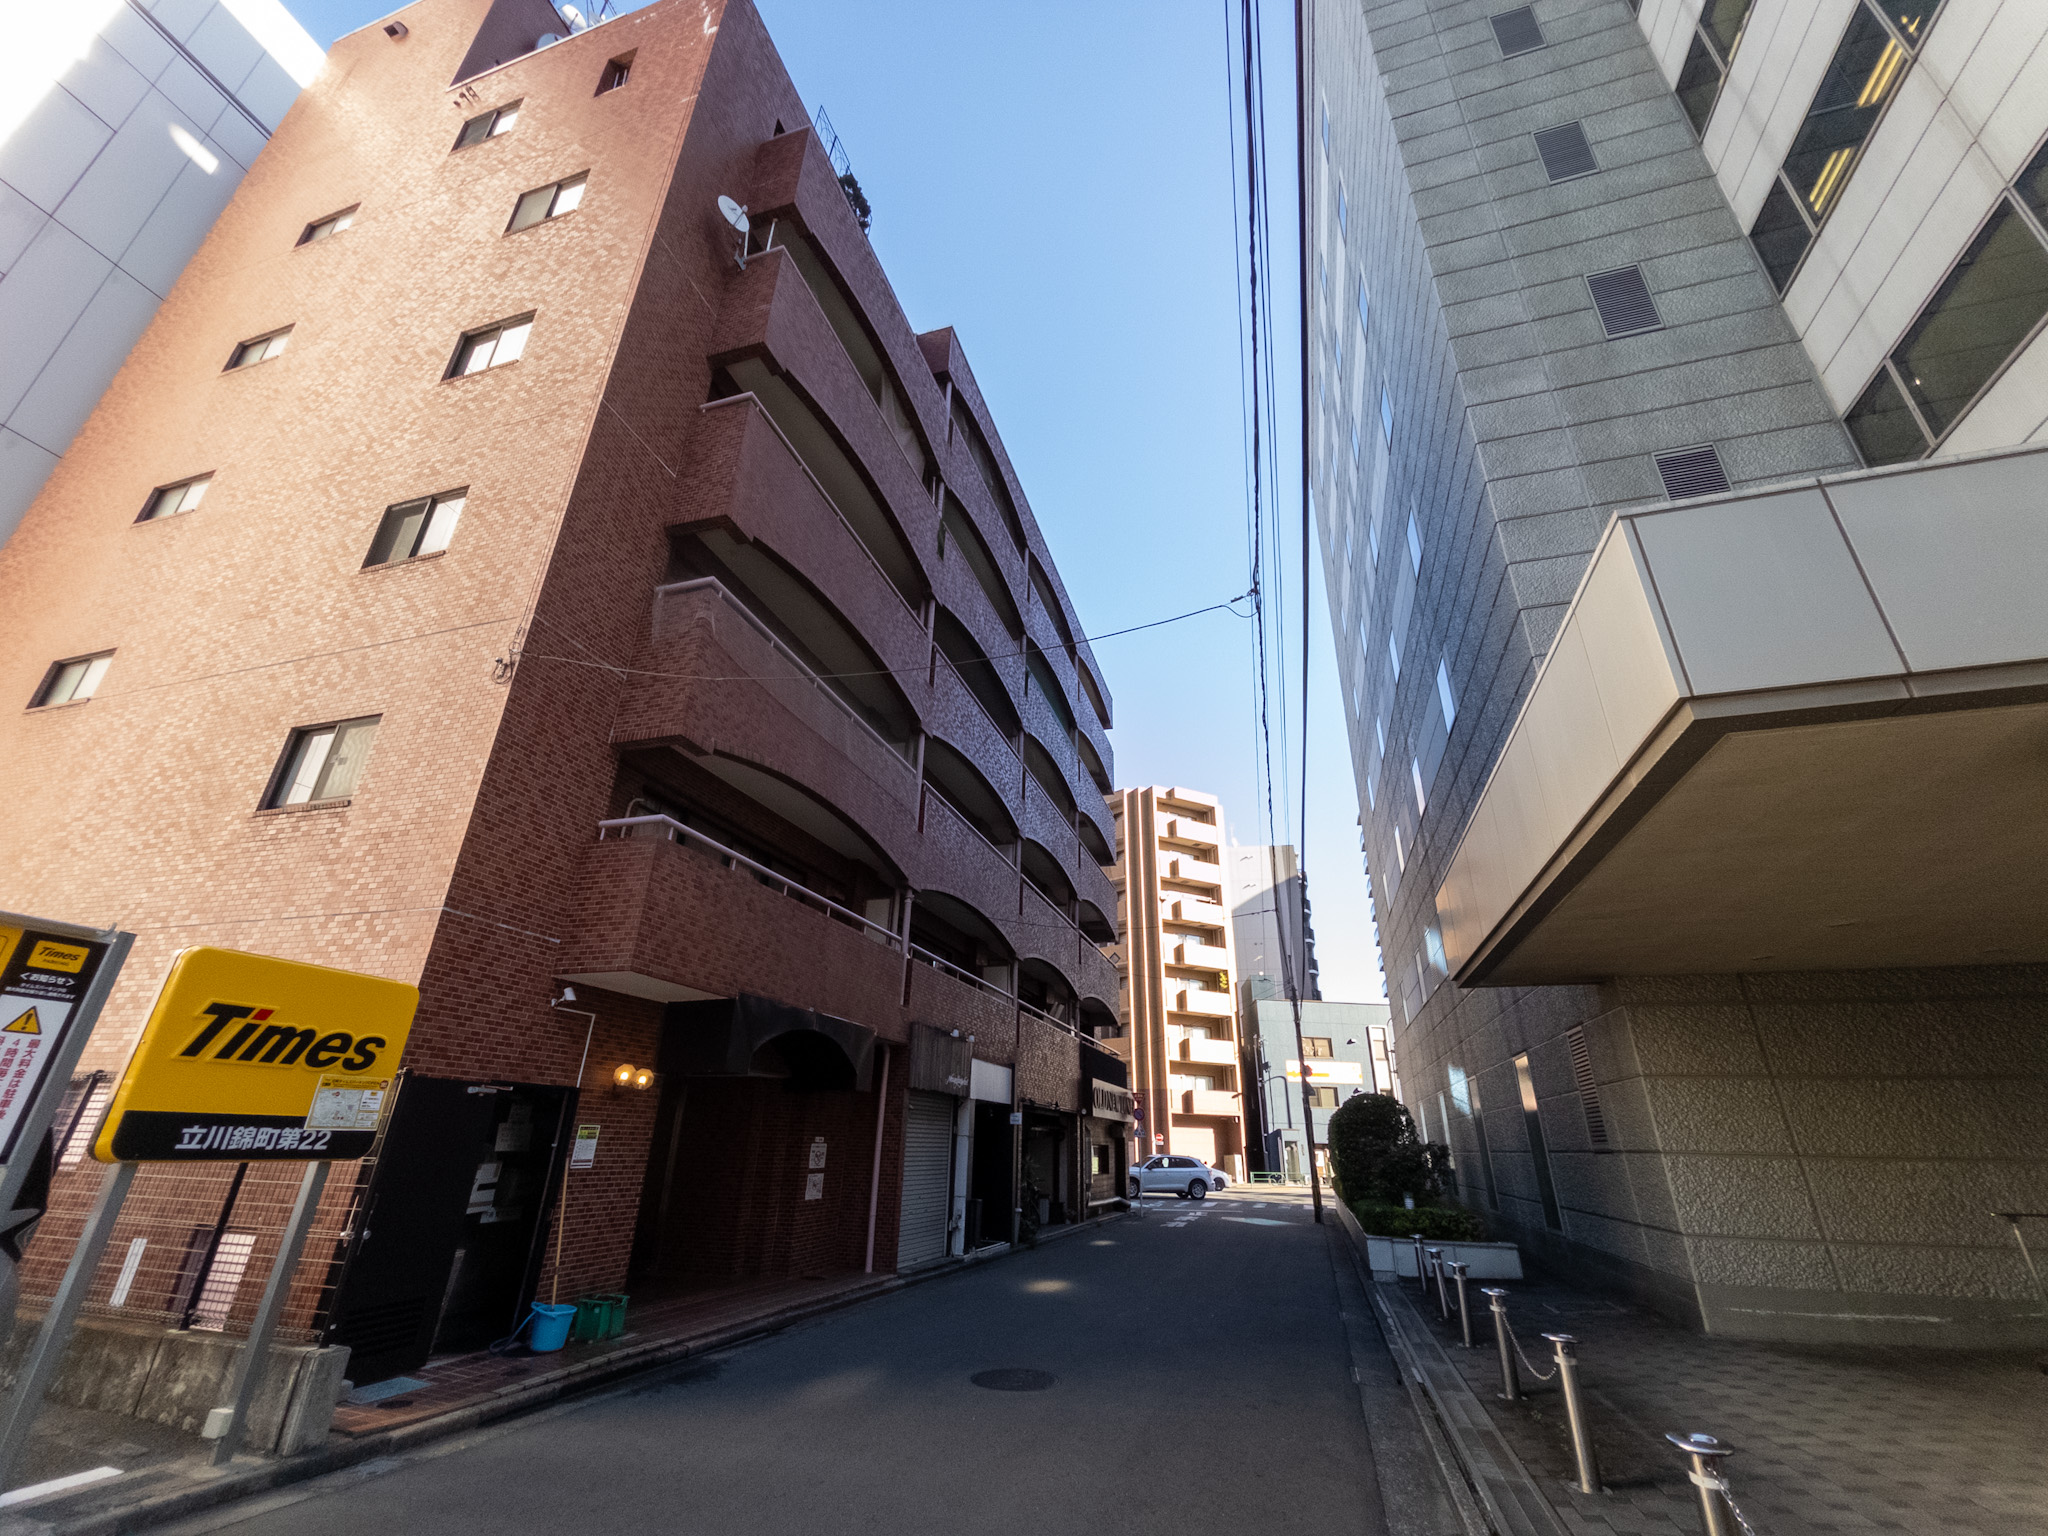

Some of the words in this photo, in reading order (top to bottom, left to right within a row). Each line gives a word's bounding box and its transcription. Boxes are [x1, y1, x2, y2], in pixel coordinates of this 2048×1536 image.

[39, 946, 81, 961] Times
[179, 1002, 387, 1072] Times
[174, 1124, 332, 1150] 立川錦町第22
